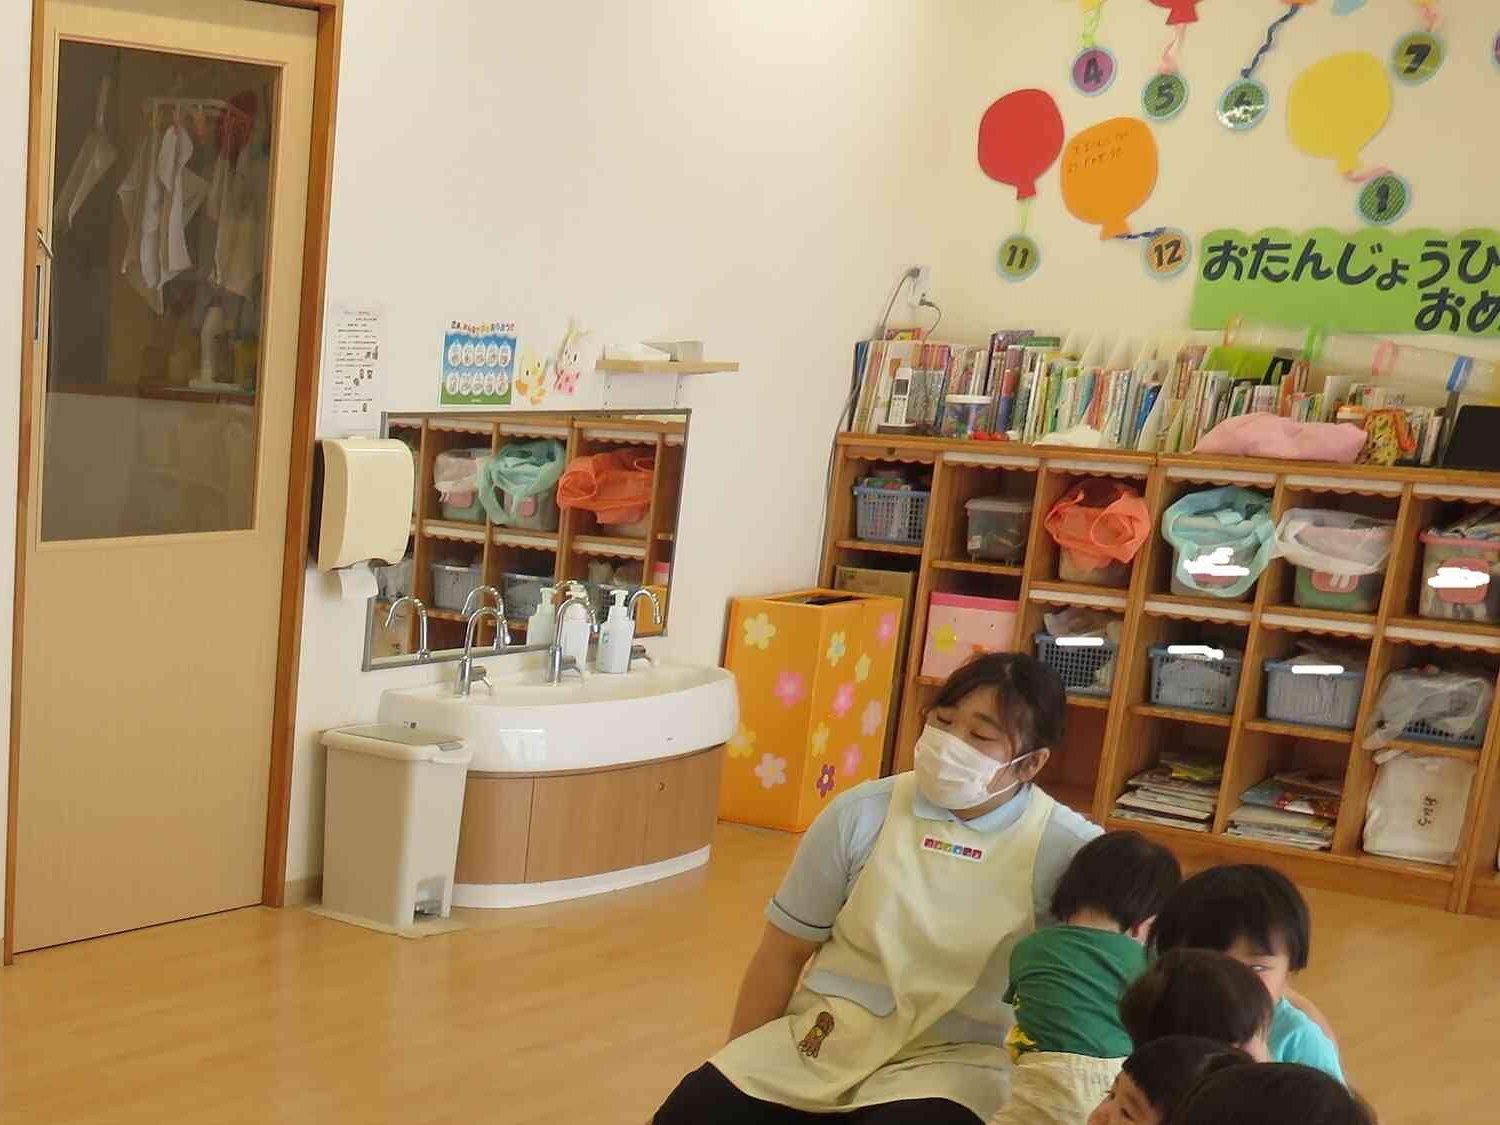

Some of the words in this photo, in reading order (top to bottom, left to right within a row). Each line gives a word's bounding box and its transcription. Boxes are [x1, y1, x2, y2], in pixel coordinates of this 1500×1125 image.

[1083, 57, 1104, 85] 4
[1404, 43, 1432, 74] 7
[1155, 82, 1176, 111] 5
[1006, 244, 1029, 269] 11
[1154, 239, 1183, 268] 12
